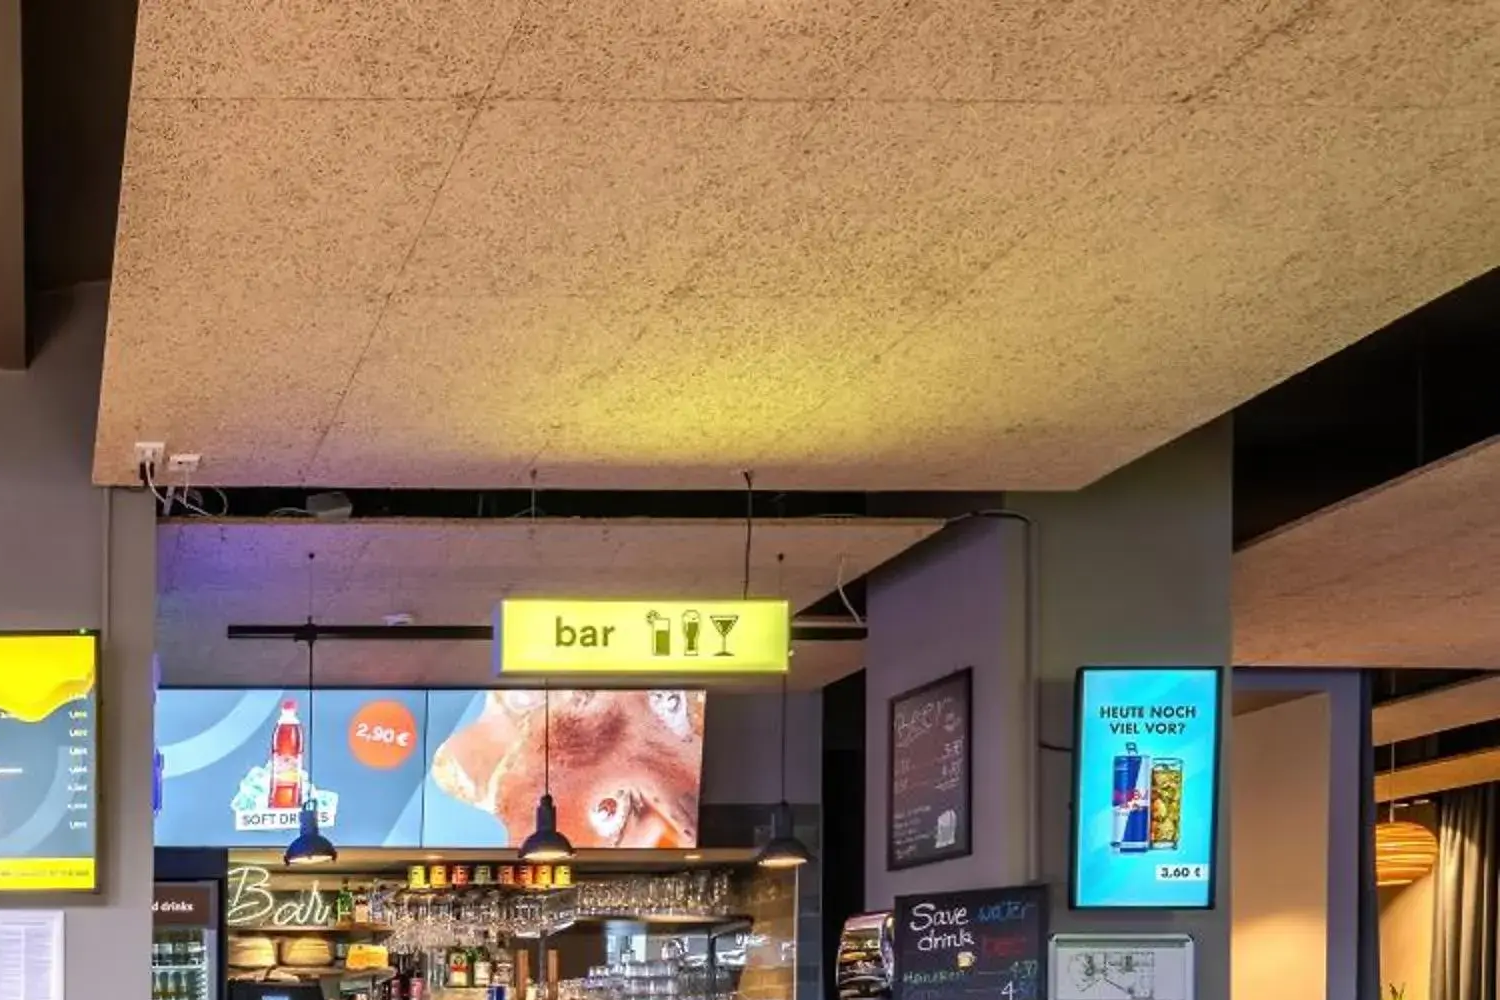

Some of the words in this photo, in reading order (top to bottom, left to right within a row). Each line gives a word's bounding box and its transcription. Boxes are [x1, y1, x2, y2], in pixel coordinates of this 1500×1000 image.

[555, 616, 615, 647] bar
[1100, 705, 1144, 719] HEUTE
[1150, 705, 1197, 719] NOCH
[1110, 722, 1140, 735] VIEL
[1145, 722, 1186, 735] VOR?
[243, 813, 277, 827] SOFT
[280, 811, 330, 826] DRIS
[227, 866, 331, 926] Bar
[160, 901, 194, 911] drinks
[910, 903, 969, 931] Save
[917, 928, 975, 951] drink
